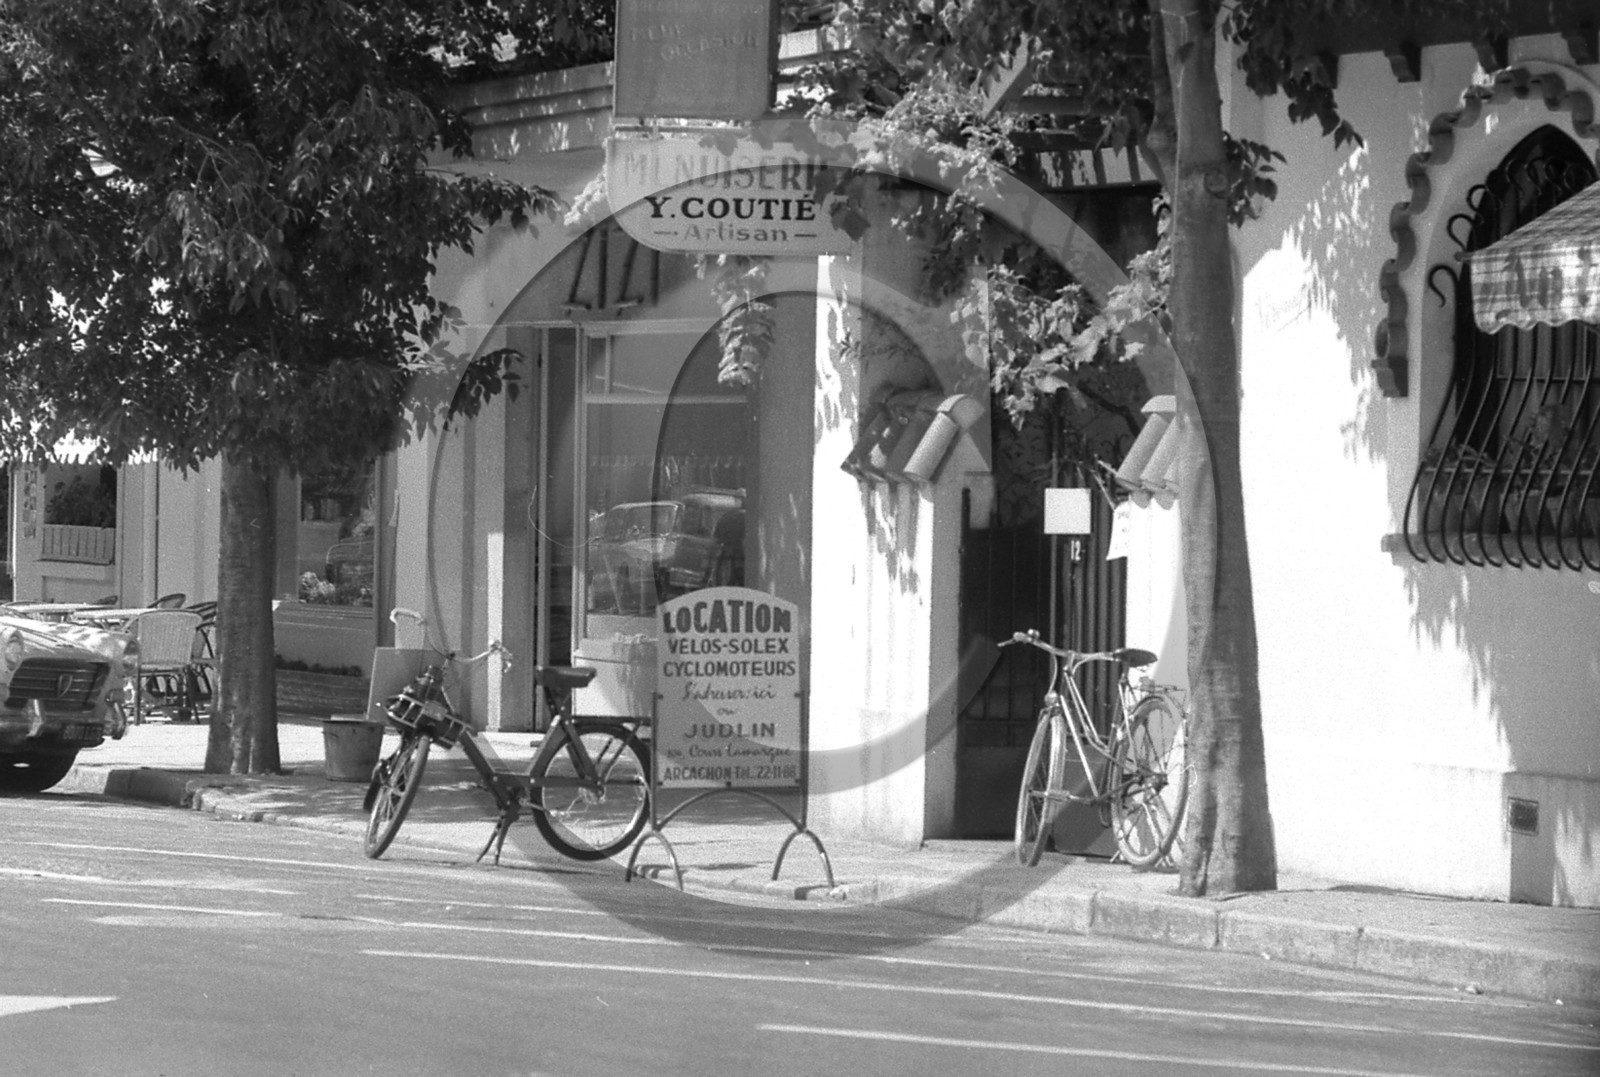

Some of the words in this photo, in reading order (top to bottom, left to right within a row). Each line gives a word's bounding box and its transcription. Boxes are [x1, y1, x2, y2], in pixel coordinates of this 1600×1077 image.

[683, 222, 789, 243] Artisan
[1070, 539, 1082, 561] 12
[663, 599, 791, 633] LOCATION
[663, 660, 796, 677] CYCLOMOTEURS
[684, 723, 776, 739] JUDLIN
